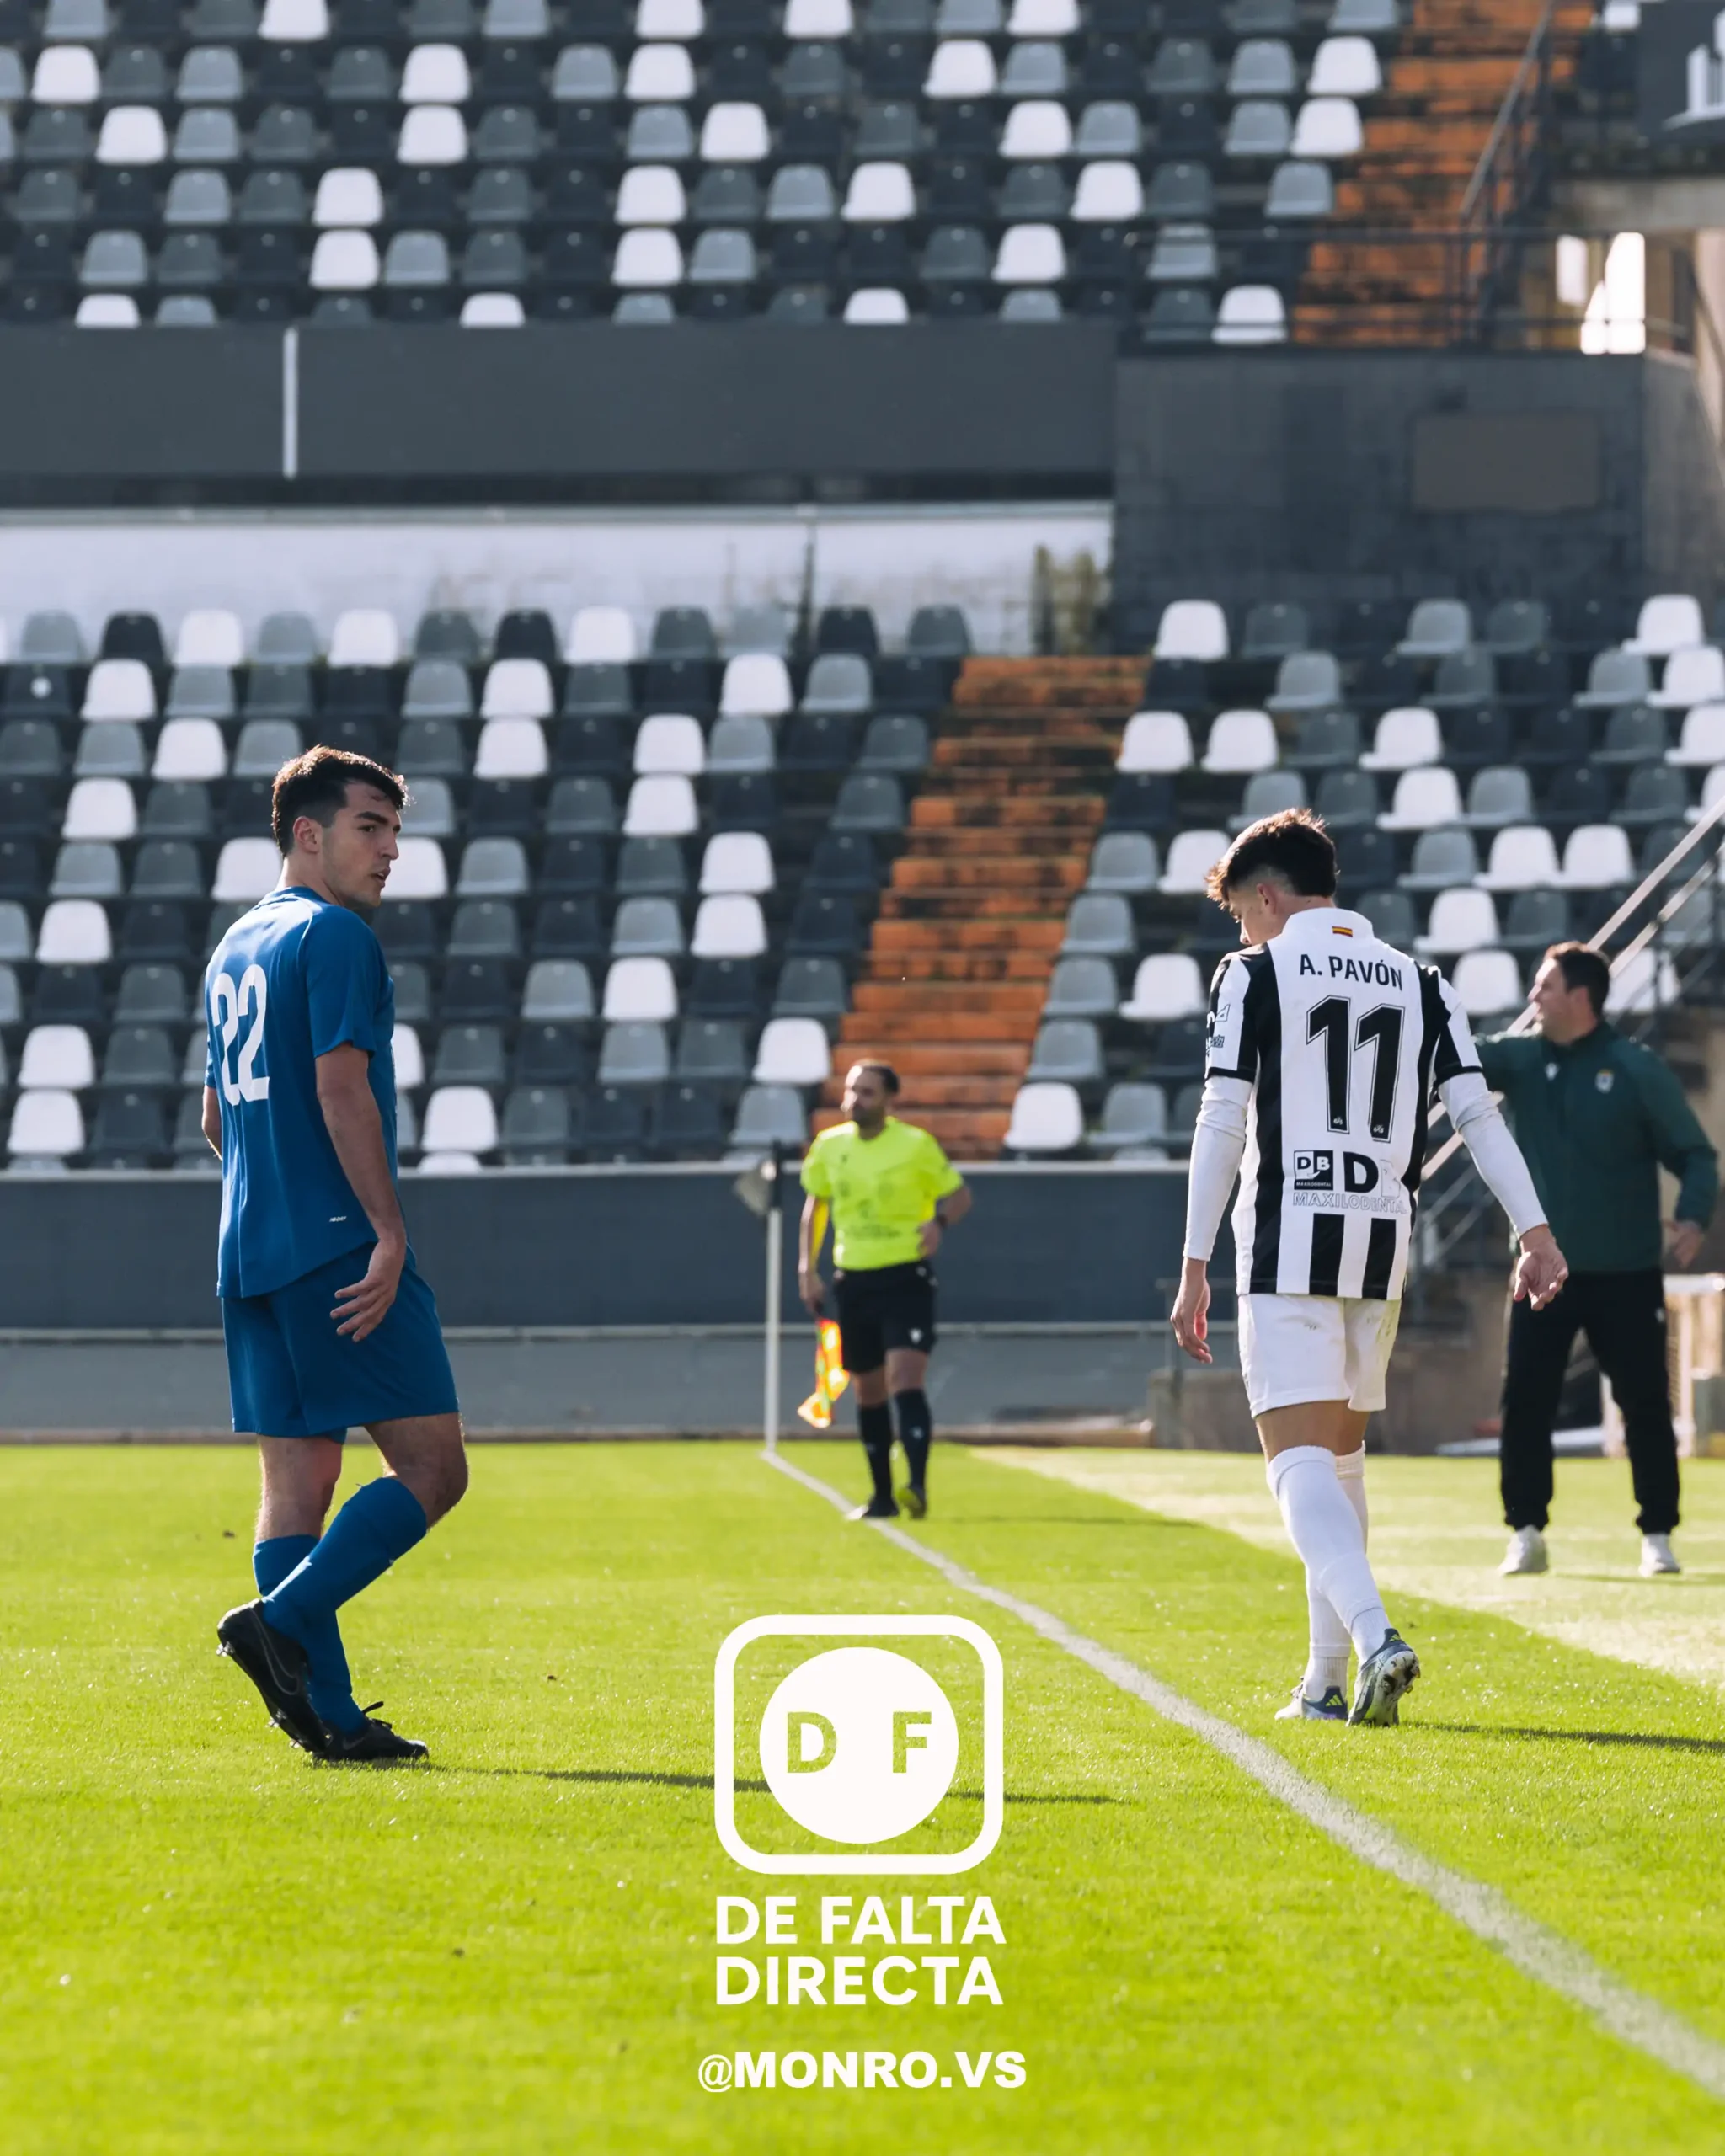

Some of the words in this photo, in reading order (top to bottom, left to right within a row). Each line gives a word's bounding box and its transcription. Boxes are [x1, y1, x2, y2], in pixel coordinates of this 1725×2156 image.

[212, 963, 270, 1106] 22
[1300, 953, 1322, 975] A.
[1328, 955, 1402, 991] PAVÓN
[1306, 995, 1405, 1143] 11
